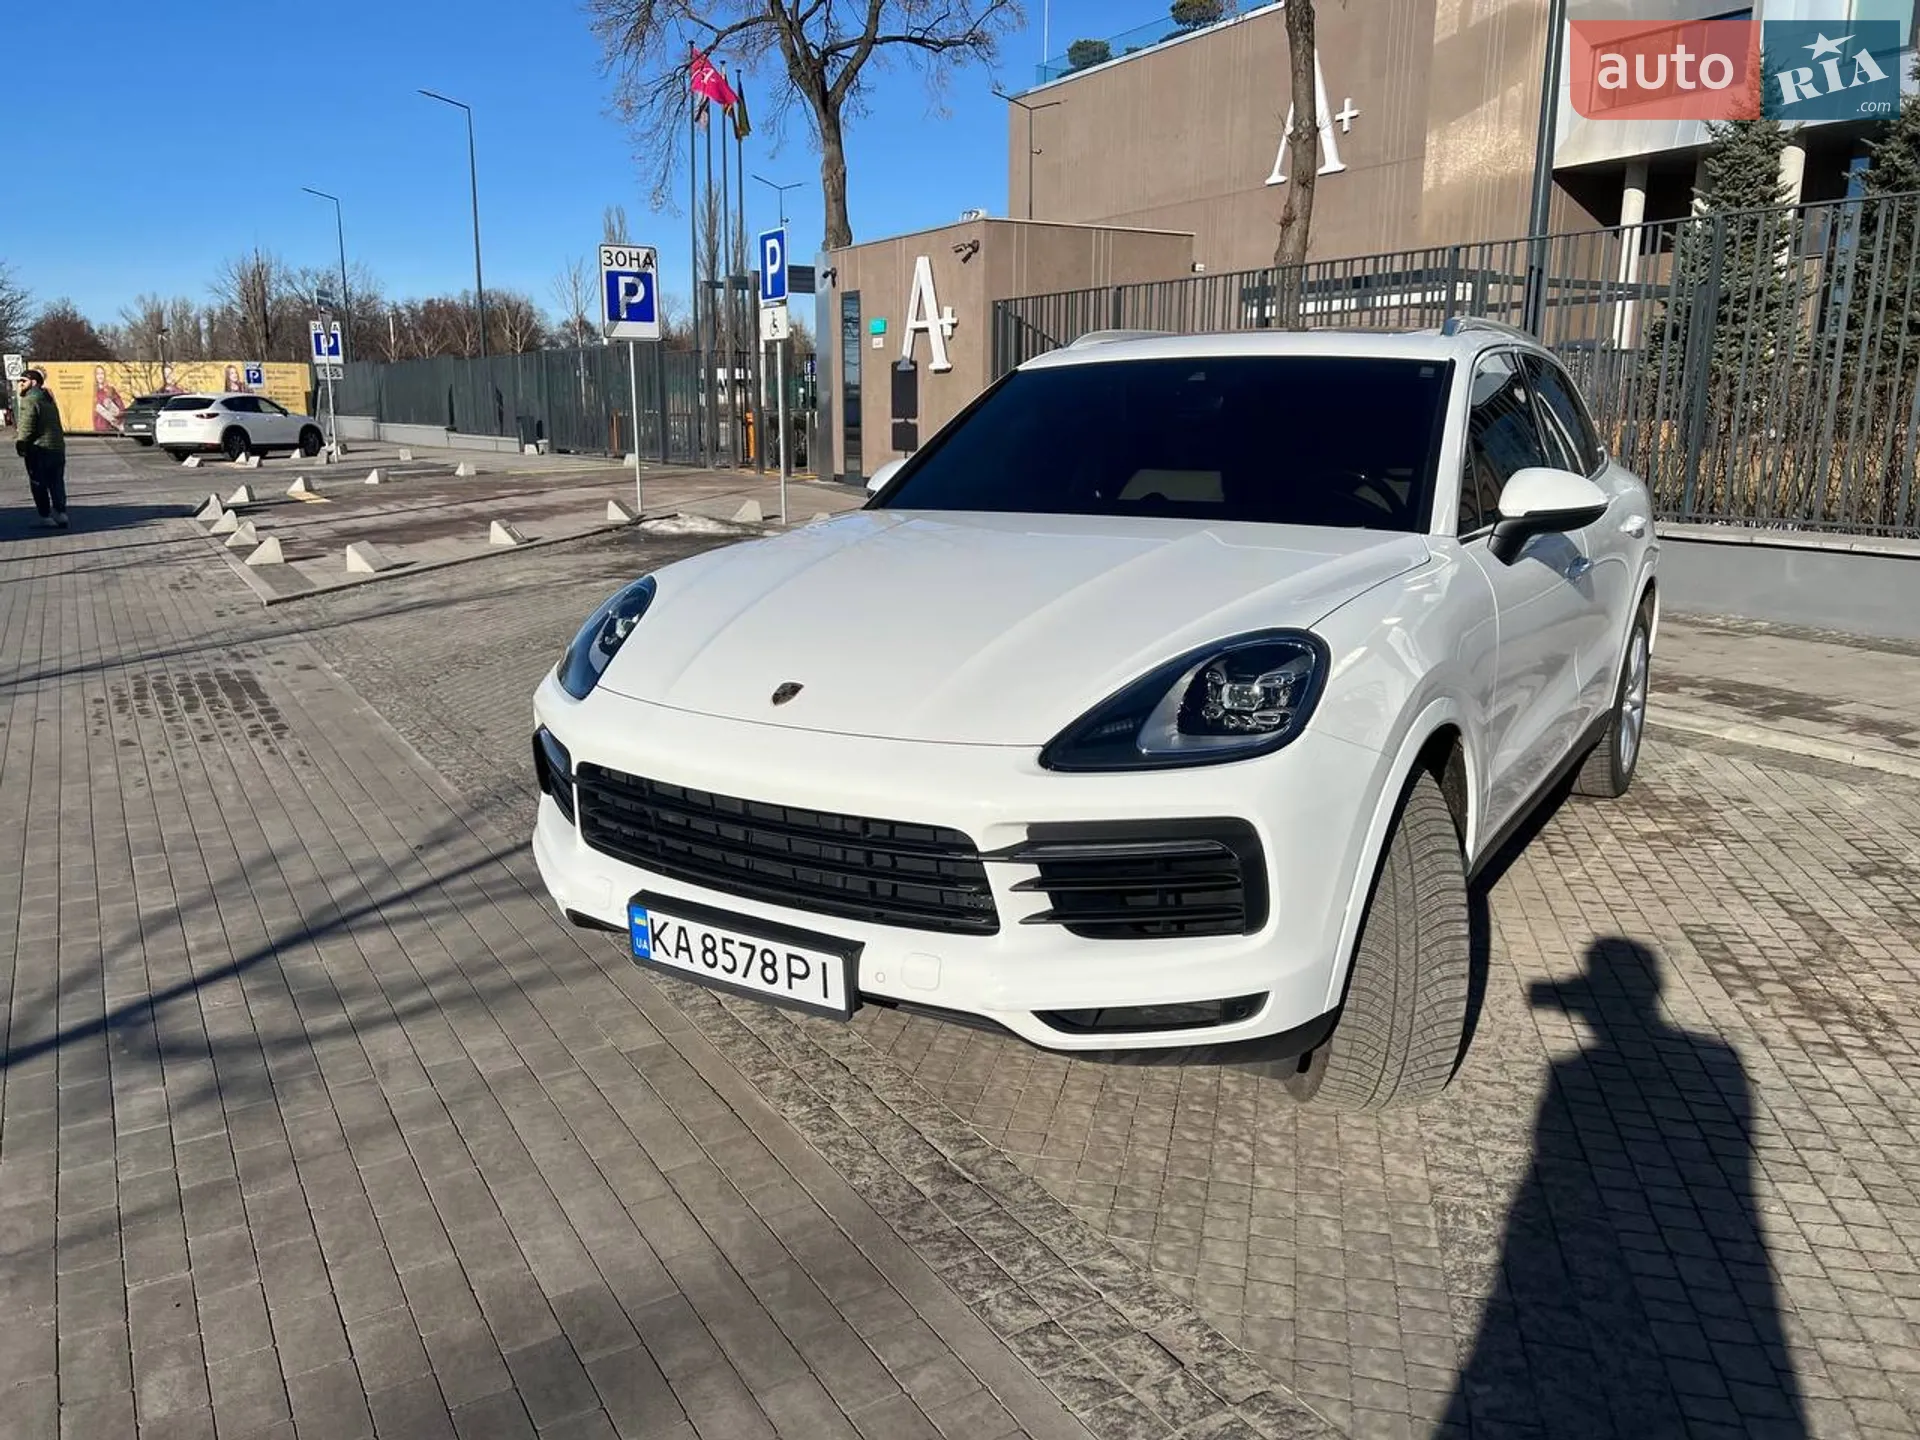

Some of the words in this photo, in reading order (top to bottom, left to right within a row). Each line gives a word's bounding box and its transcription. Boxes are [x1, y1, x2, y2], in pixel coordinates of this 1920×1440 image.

[603, 250, 654, 268] ЗОНА
[765, 238, 781, 295] P
[618, 276, 645, 319] P
[636, 937, 649, 950] UA
